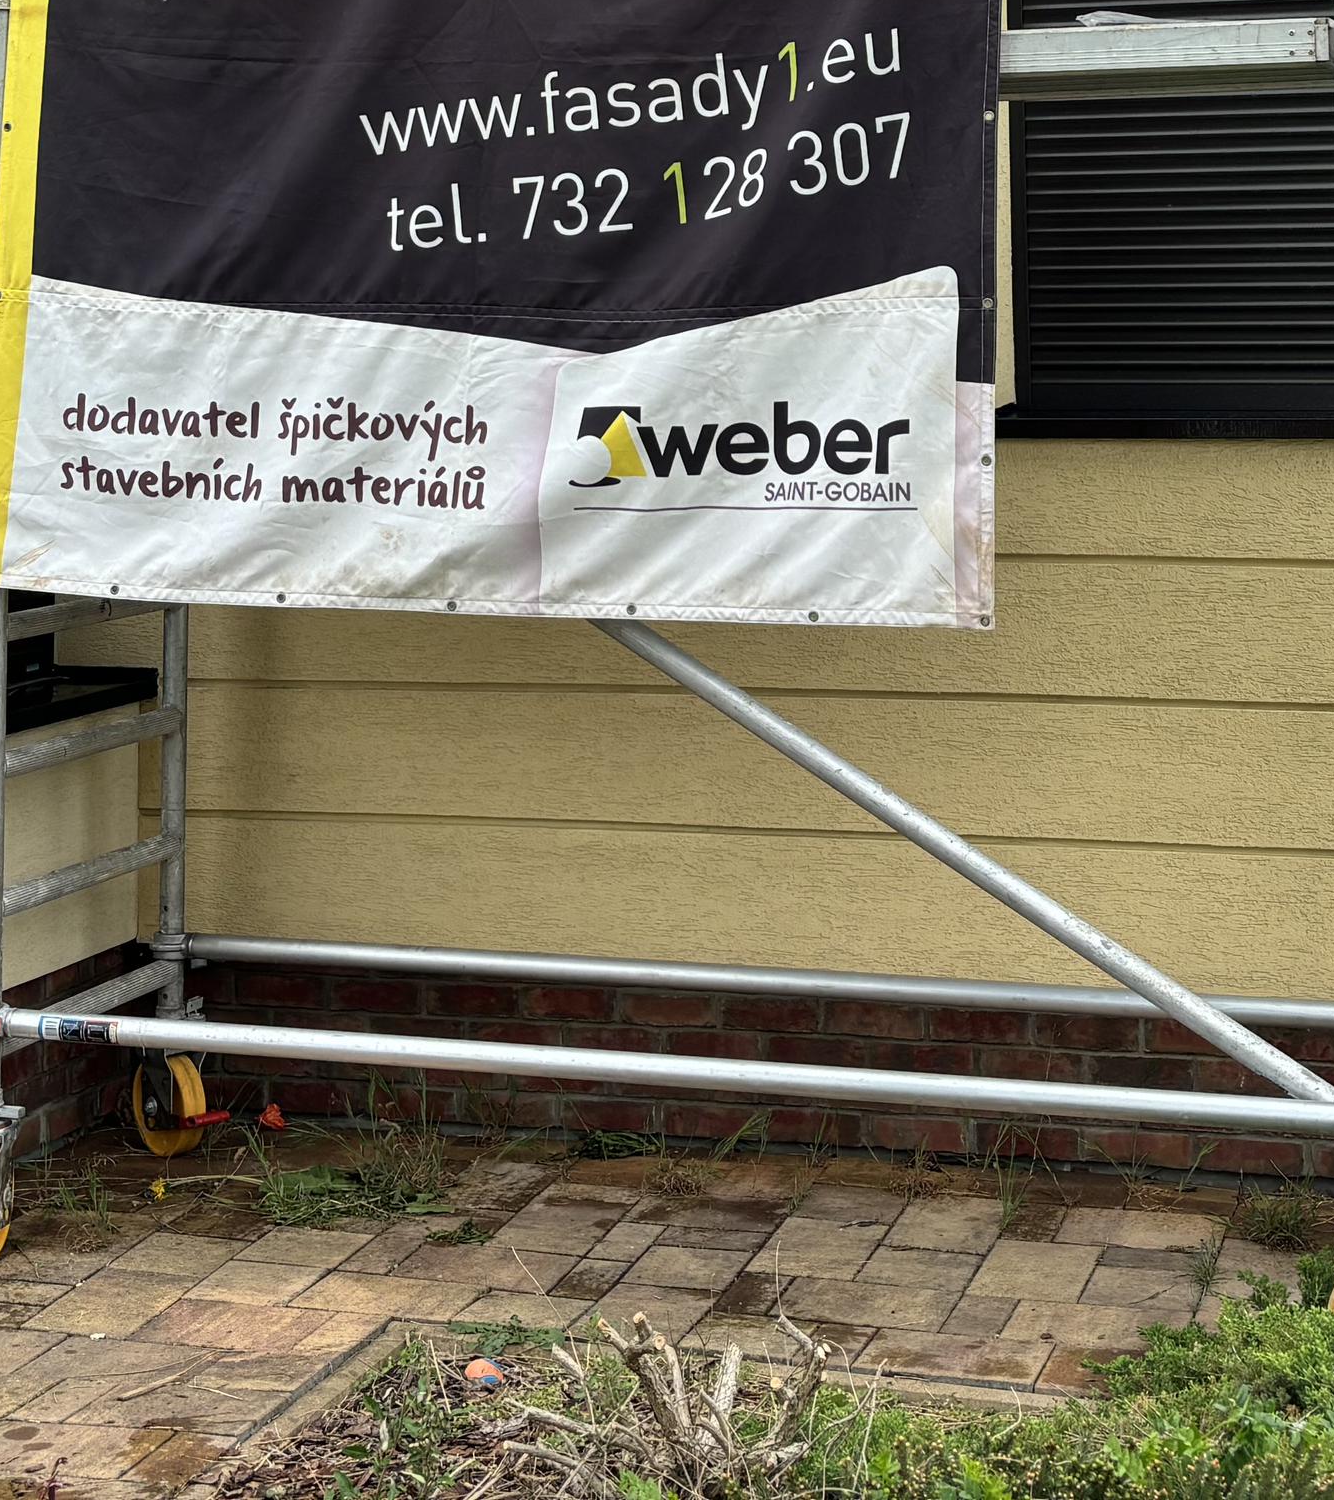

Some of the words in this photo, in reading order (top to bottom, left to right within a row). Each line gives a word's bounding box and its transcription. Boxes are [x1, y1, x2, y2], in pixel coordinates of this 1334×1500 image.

[359, 27, 901, 157] www.fasady1.eu
[386, 183, 488, 252] tel.
[512, 168, 634, 240] 732
[663, 148, 765, 225] 128
[787, 111, 911, 196] 307
[62, 393, 260, 439] dodavatel
[278, 396, 488, 462] špičkových
[643, 400, 910, 477] weber
[60, 455, 262, 503] stavebních
[282, 465, 486, 510] materiálů
[764, 481, 911, 503] SAINT-GOBAIN
